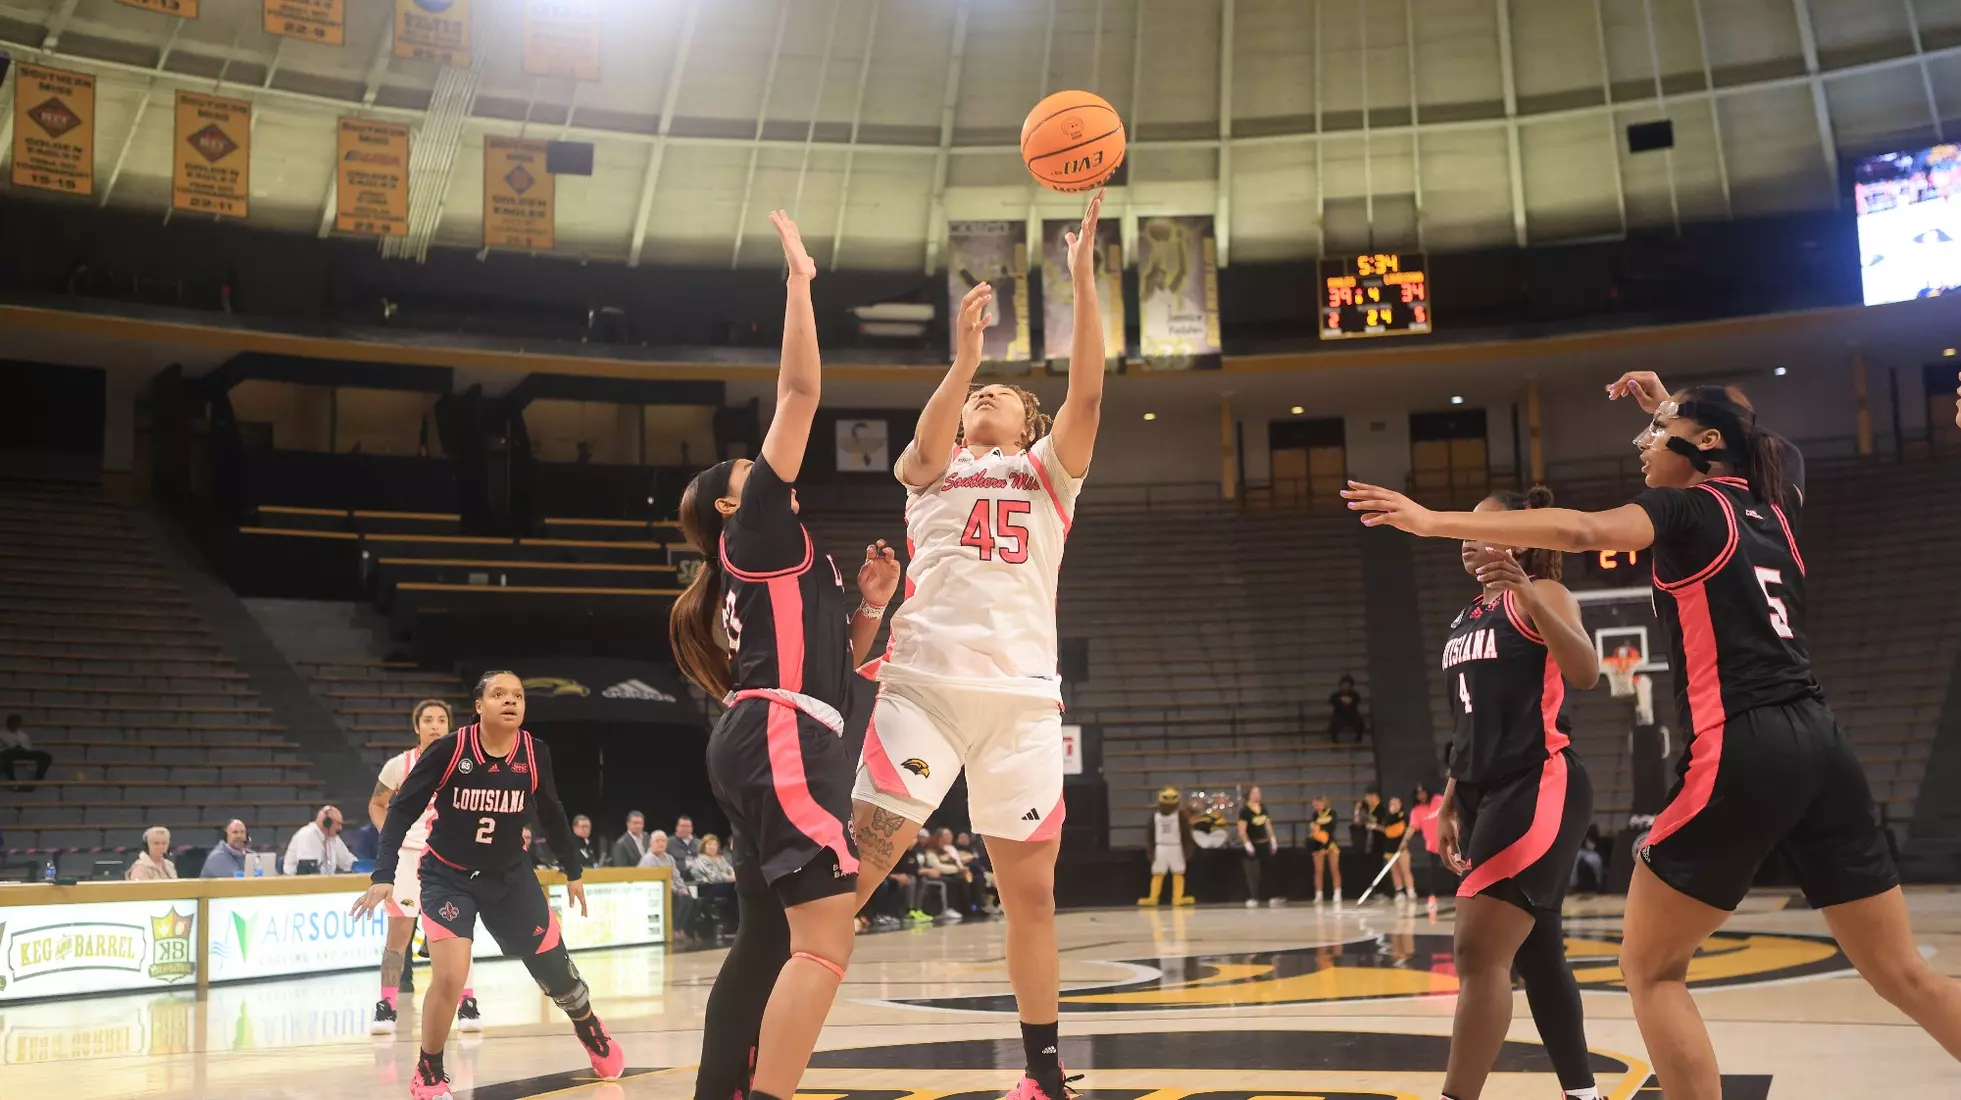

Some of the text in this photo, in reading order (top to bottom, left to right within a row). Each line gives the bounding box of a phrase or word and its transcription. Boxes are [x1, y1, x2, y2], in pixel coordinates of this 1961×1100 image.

[1358, 254, 1397, 276] 5:34
[941, 468, 1040, 491] Southern Mis
[960, 498, 1031, 564] 45
[1753, 565, 1794, 639] 5
[1442, 628, 1498, 671] UISIANA
[1459, 672, 1473, 714] 4
[475, 817, 496, 844] 2
[20, 938, 52, 967] KEG
[74, 934, 135, 959] BARREL
